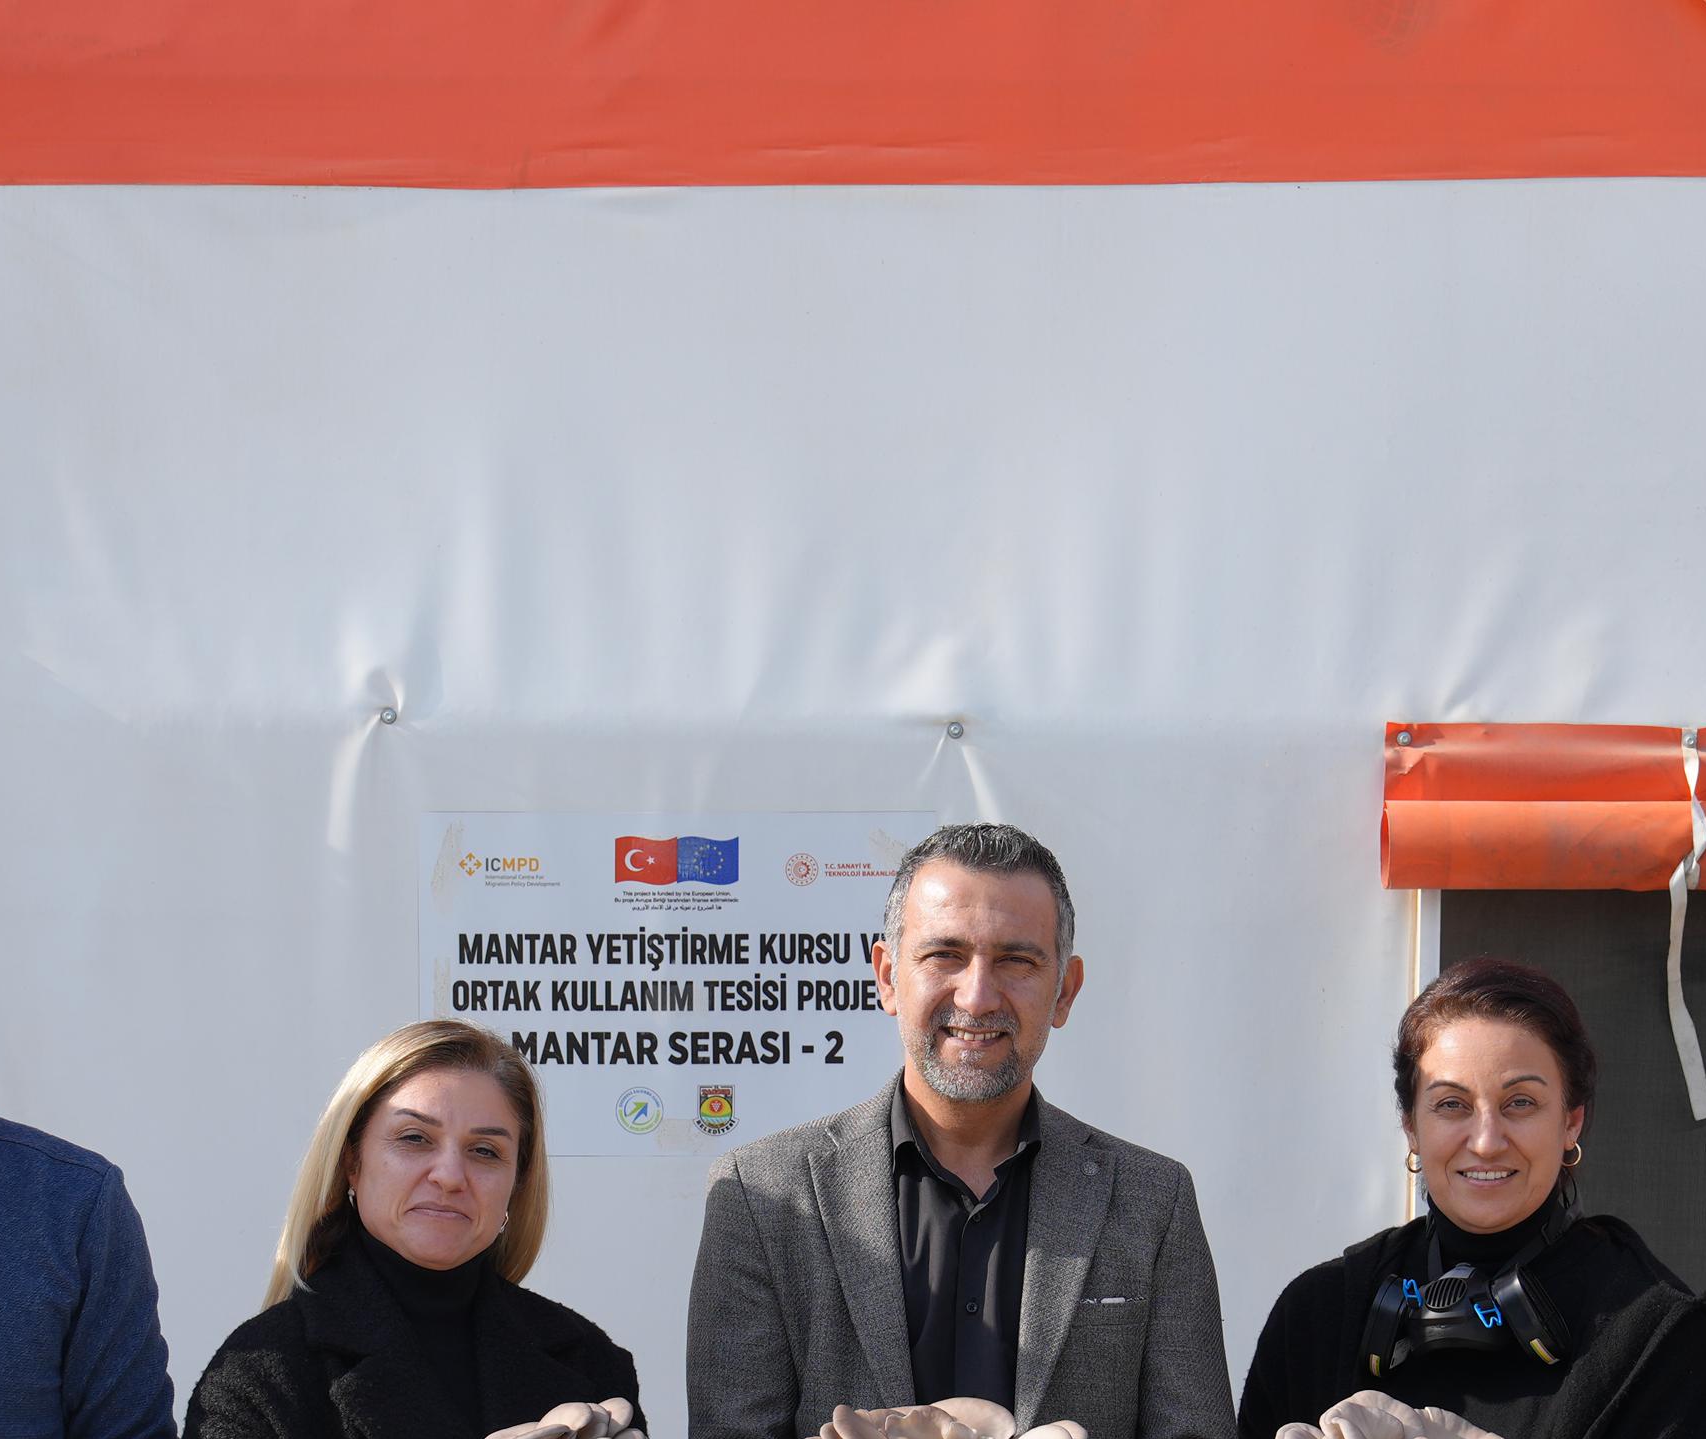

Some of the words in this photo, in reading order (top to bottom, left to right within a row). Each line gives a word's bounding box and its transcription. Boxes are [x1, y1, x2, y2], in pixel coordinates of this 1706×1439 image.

[485, 857, 540, 872] ICMPD
[458, 933, 577, 965] MANTAR
[586, 926, 750, 972] YETİŞTİRME
[759, 932, 851, 965] KURSU
[860, 931, 885, 964] V
[452, 980, 542, 1012] ORTAK
[552, 980, 694, 1012] KULLANIM
[703, 973, 787, 1012] TESİSİ
[797, 979, 884, 1012] PROJE
[511, 1031, 659, 1065] MANTAR
[667, 1031, 791, 1066] SERASI
[801, 1045, 815, 1054] -
[824, 1031, 844, 1064] 2
